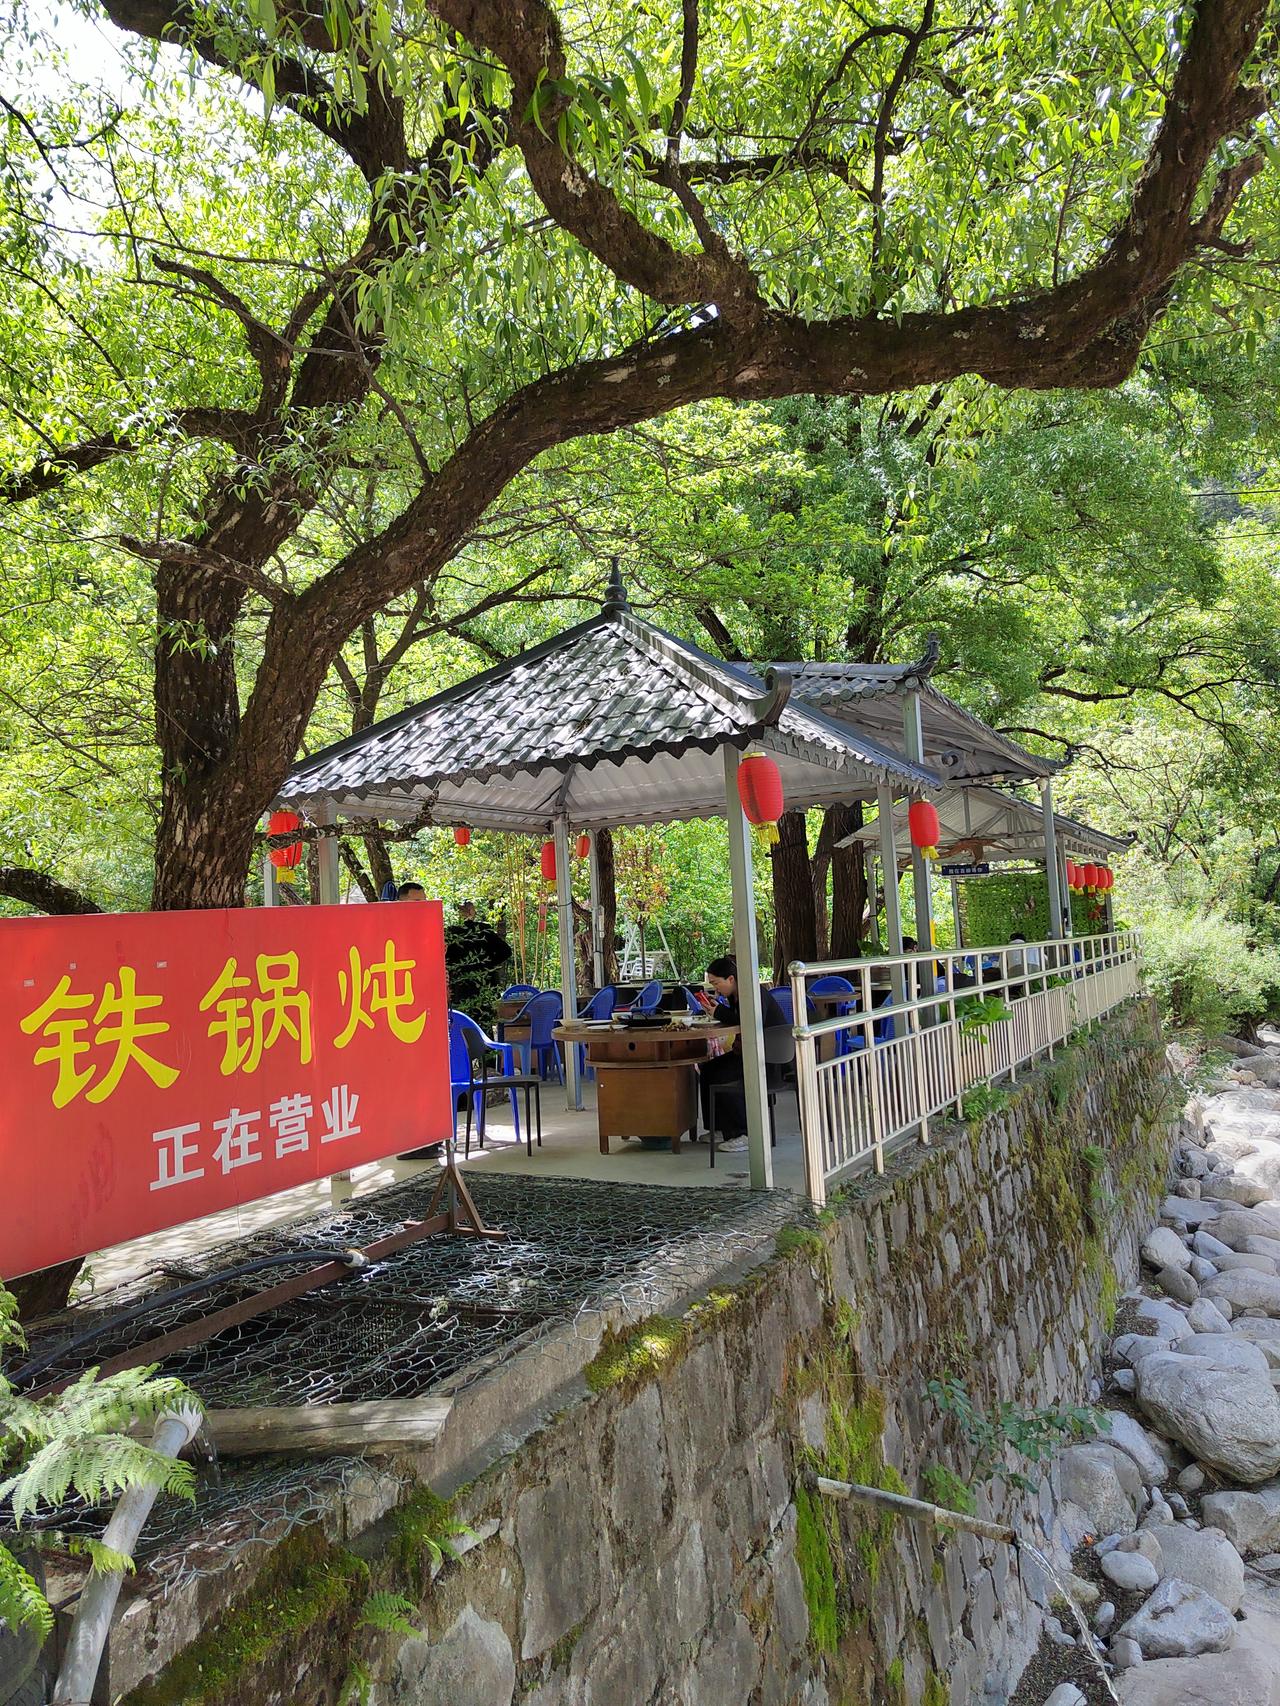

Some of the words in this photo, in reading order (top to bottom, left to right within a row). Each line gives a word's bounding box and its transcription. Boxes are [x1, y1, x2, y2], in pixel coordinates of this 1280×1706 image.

[20, 939, 427, 1109] 铁锅炖
[149, 1084, 361, 1192] 正在营业
